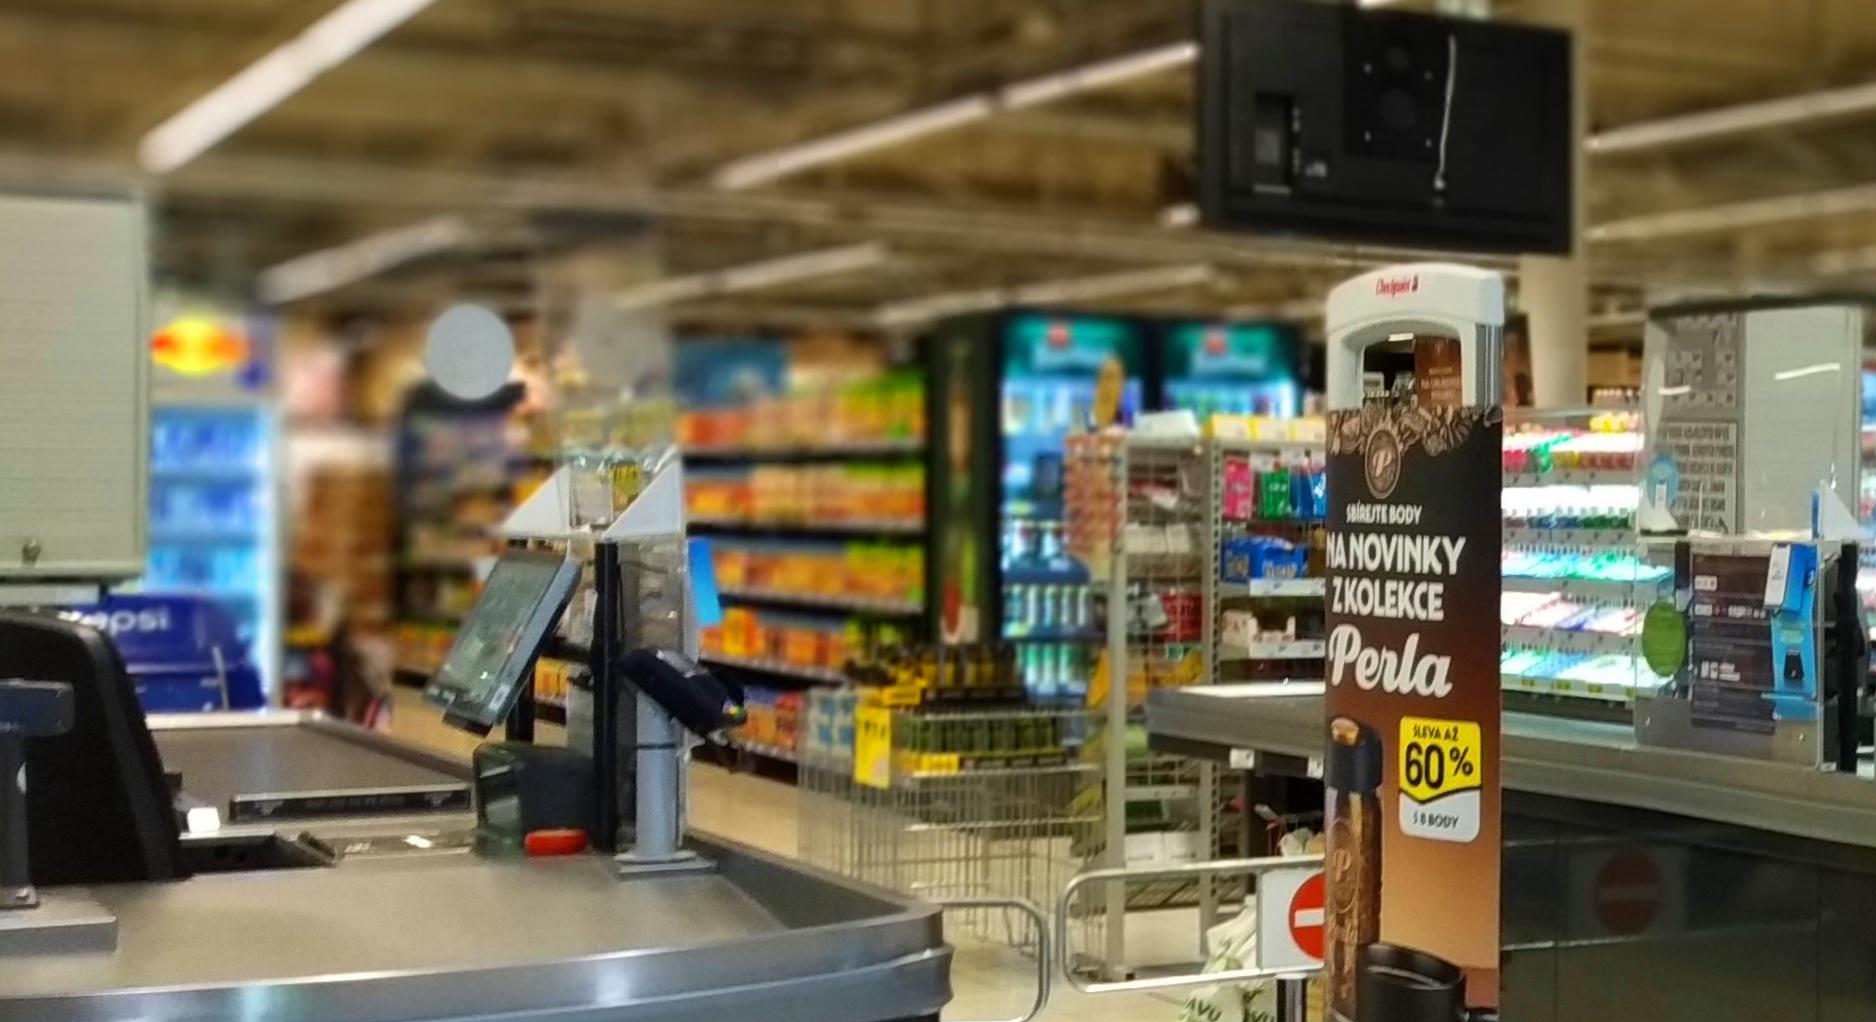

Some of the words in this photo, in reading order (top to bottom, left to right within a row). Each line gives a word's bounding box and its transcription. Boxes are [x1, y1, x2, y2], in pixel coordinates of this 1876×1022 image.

[1389, 503, 1423, 526] BODY
[1326, 531, 1347, 570] NA
[1350, 532, 1467, 576] NOVINKY
[1332, 576, 1343, 614] Z
[1344, 576, 1445, 622] KOLEKCE
[1328, 623, 1453, 699] Perla
[1413, 723, 1441, 740] SLEVA
[1428, 813, 1459, 829] BODY
